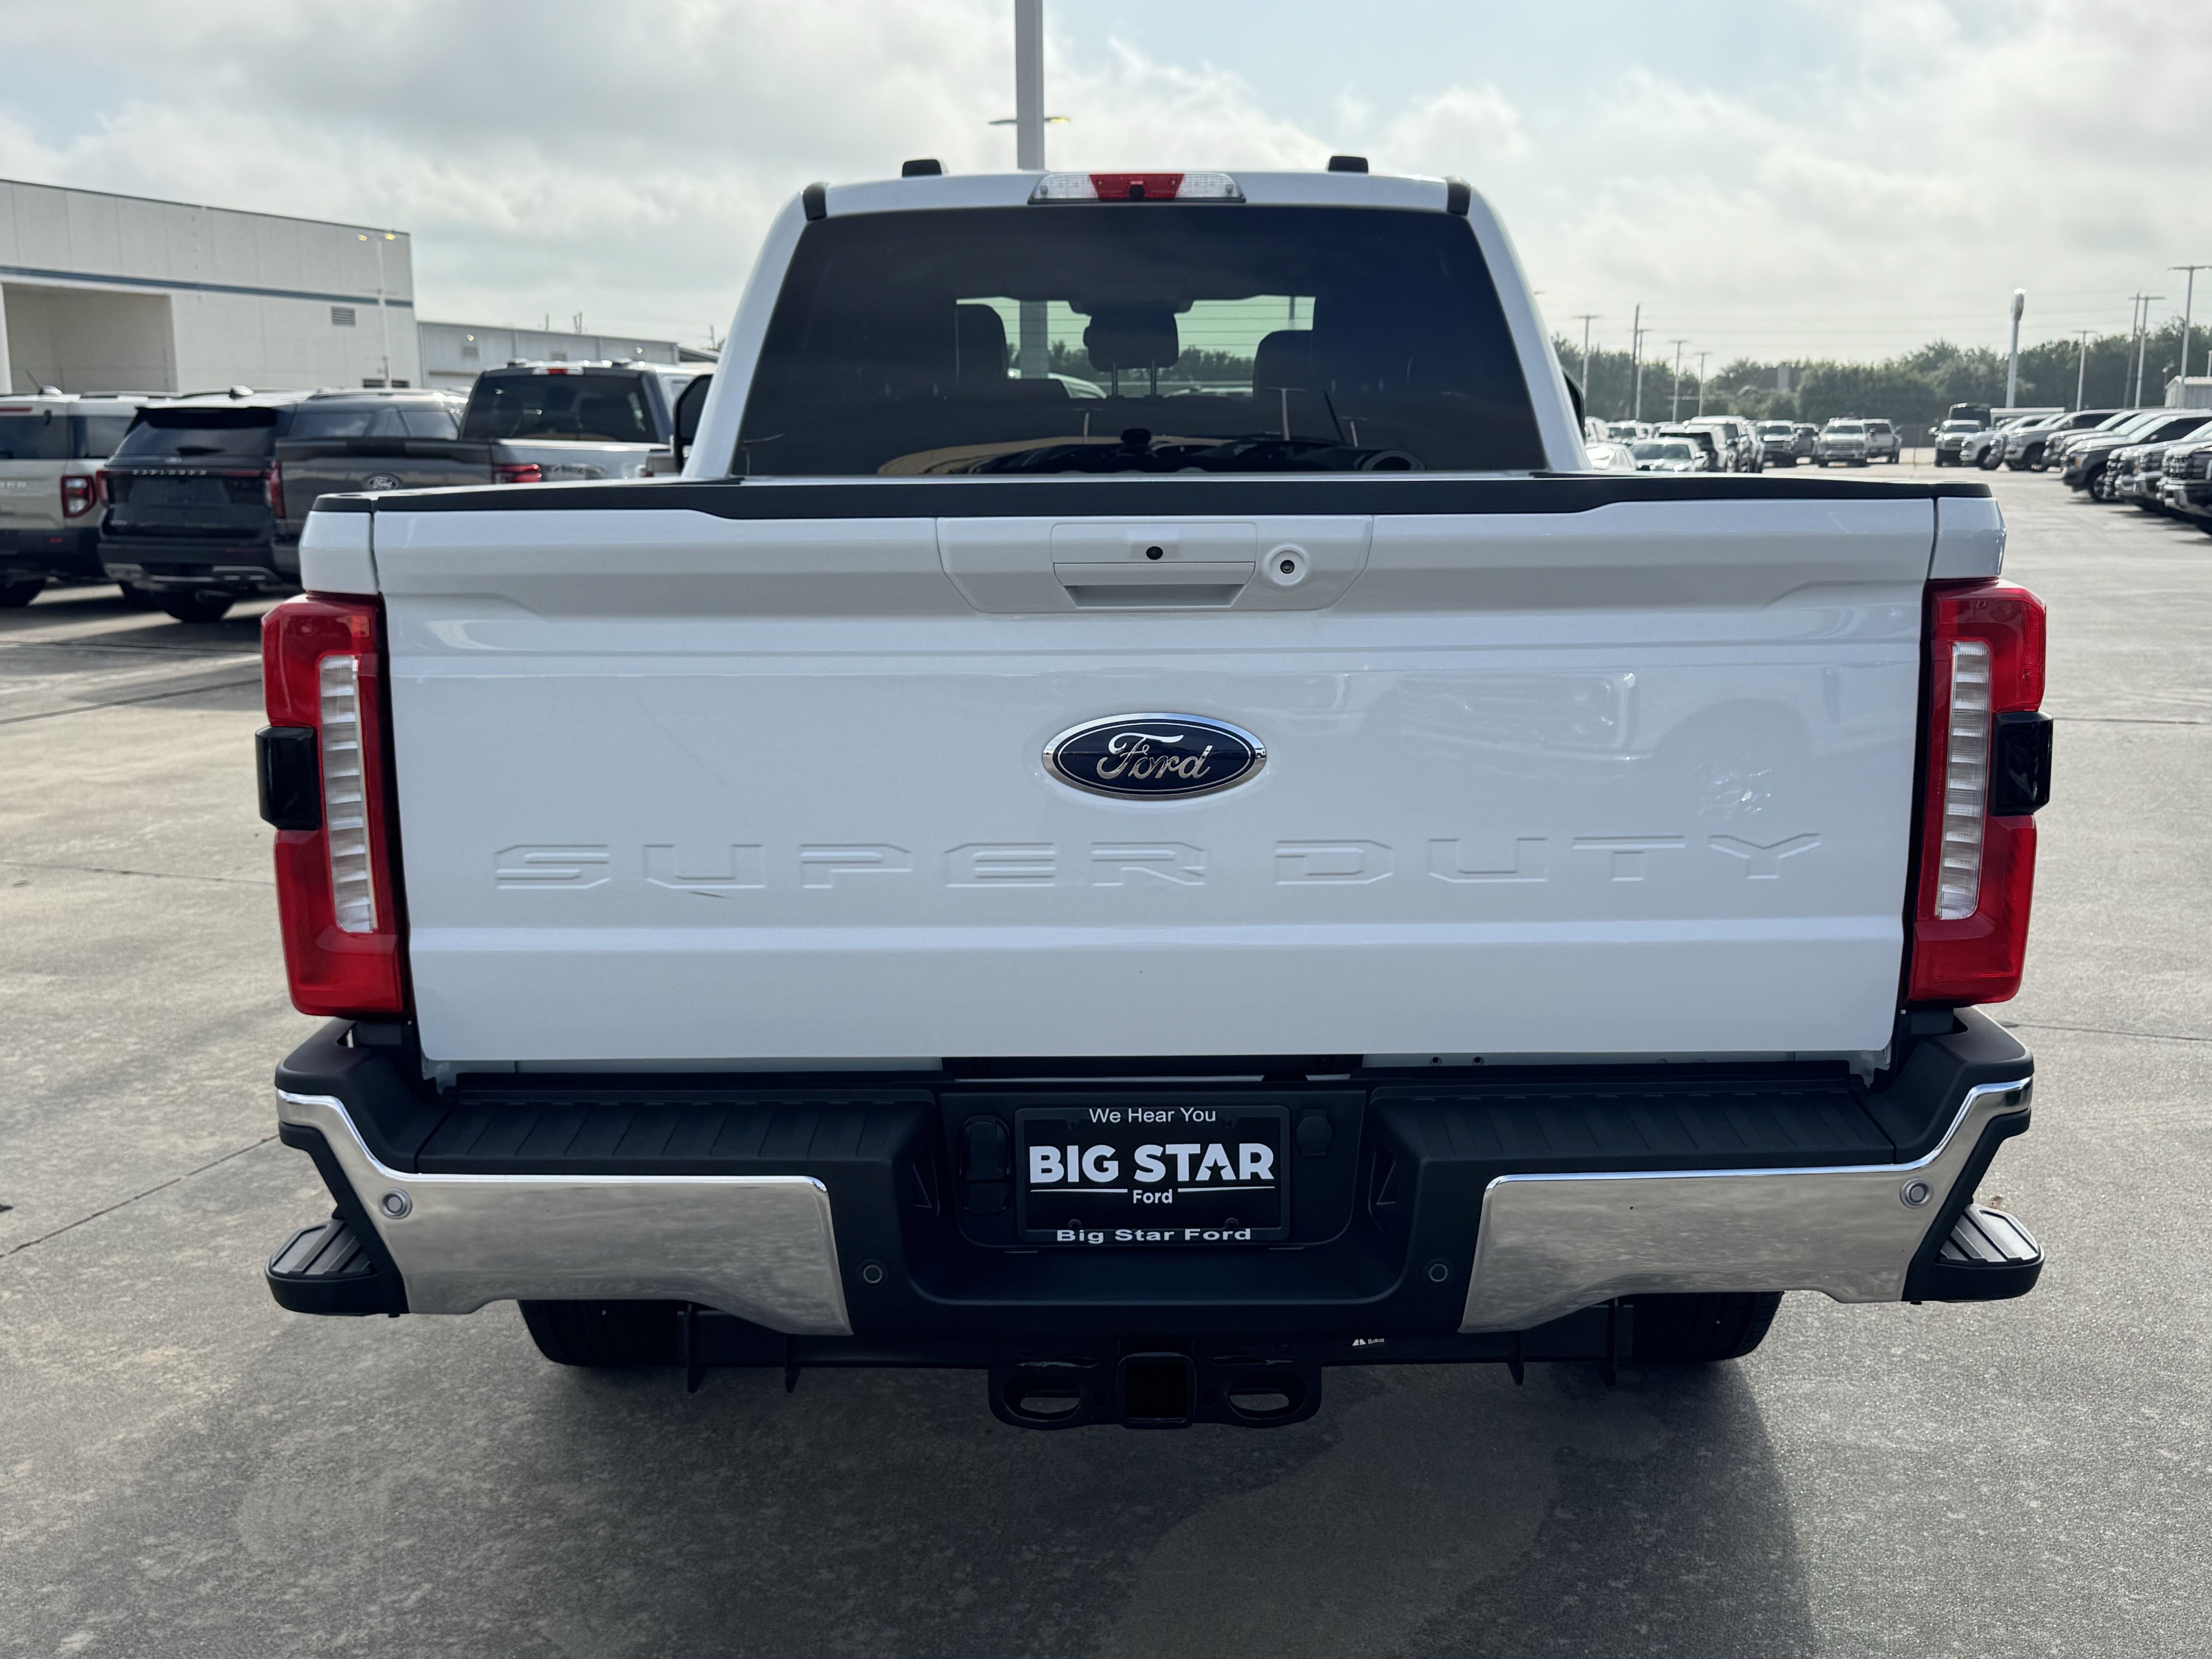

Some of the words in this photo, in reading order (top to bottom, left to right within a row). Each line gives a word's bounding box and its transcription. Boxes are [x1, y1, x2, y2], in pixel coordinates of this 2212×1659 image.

[1096, 732, 1213, 779] Ford
[495, 842, 1207, 889] SUPER
[1275, 834, 1821, 884] DUTY
[1089, 1108, 1121, 1123] We
[1128, 1107, 1175, 1123] Hear
[1180, 1106, 1216, 1122] You
[1029, 1145, 1119, 1183] BIG
[1134, 1143, 1274, 1182] STAR
[1133, 1188, 1173, 1204] Ford
[1057, 1229, 1104, 1244] Big
[1115, 1229, 1175, 1241] Star
[1185, 1228, 1251, 1241] Ford
